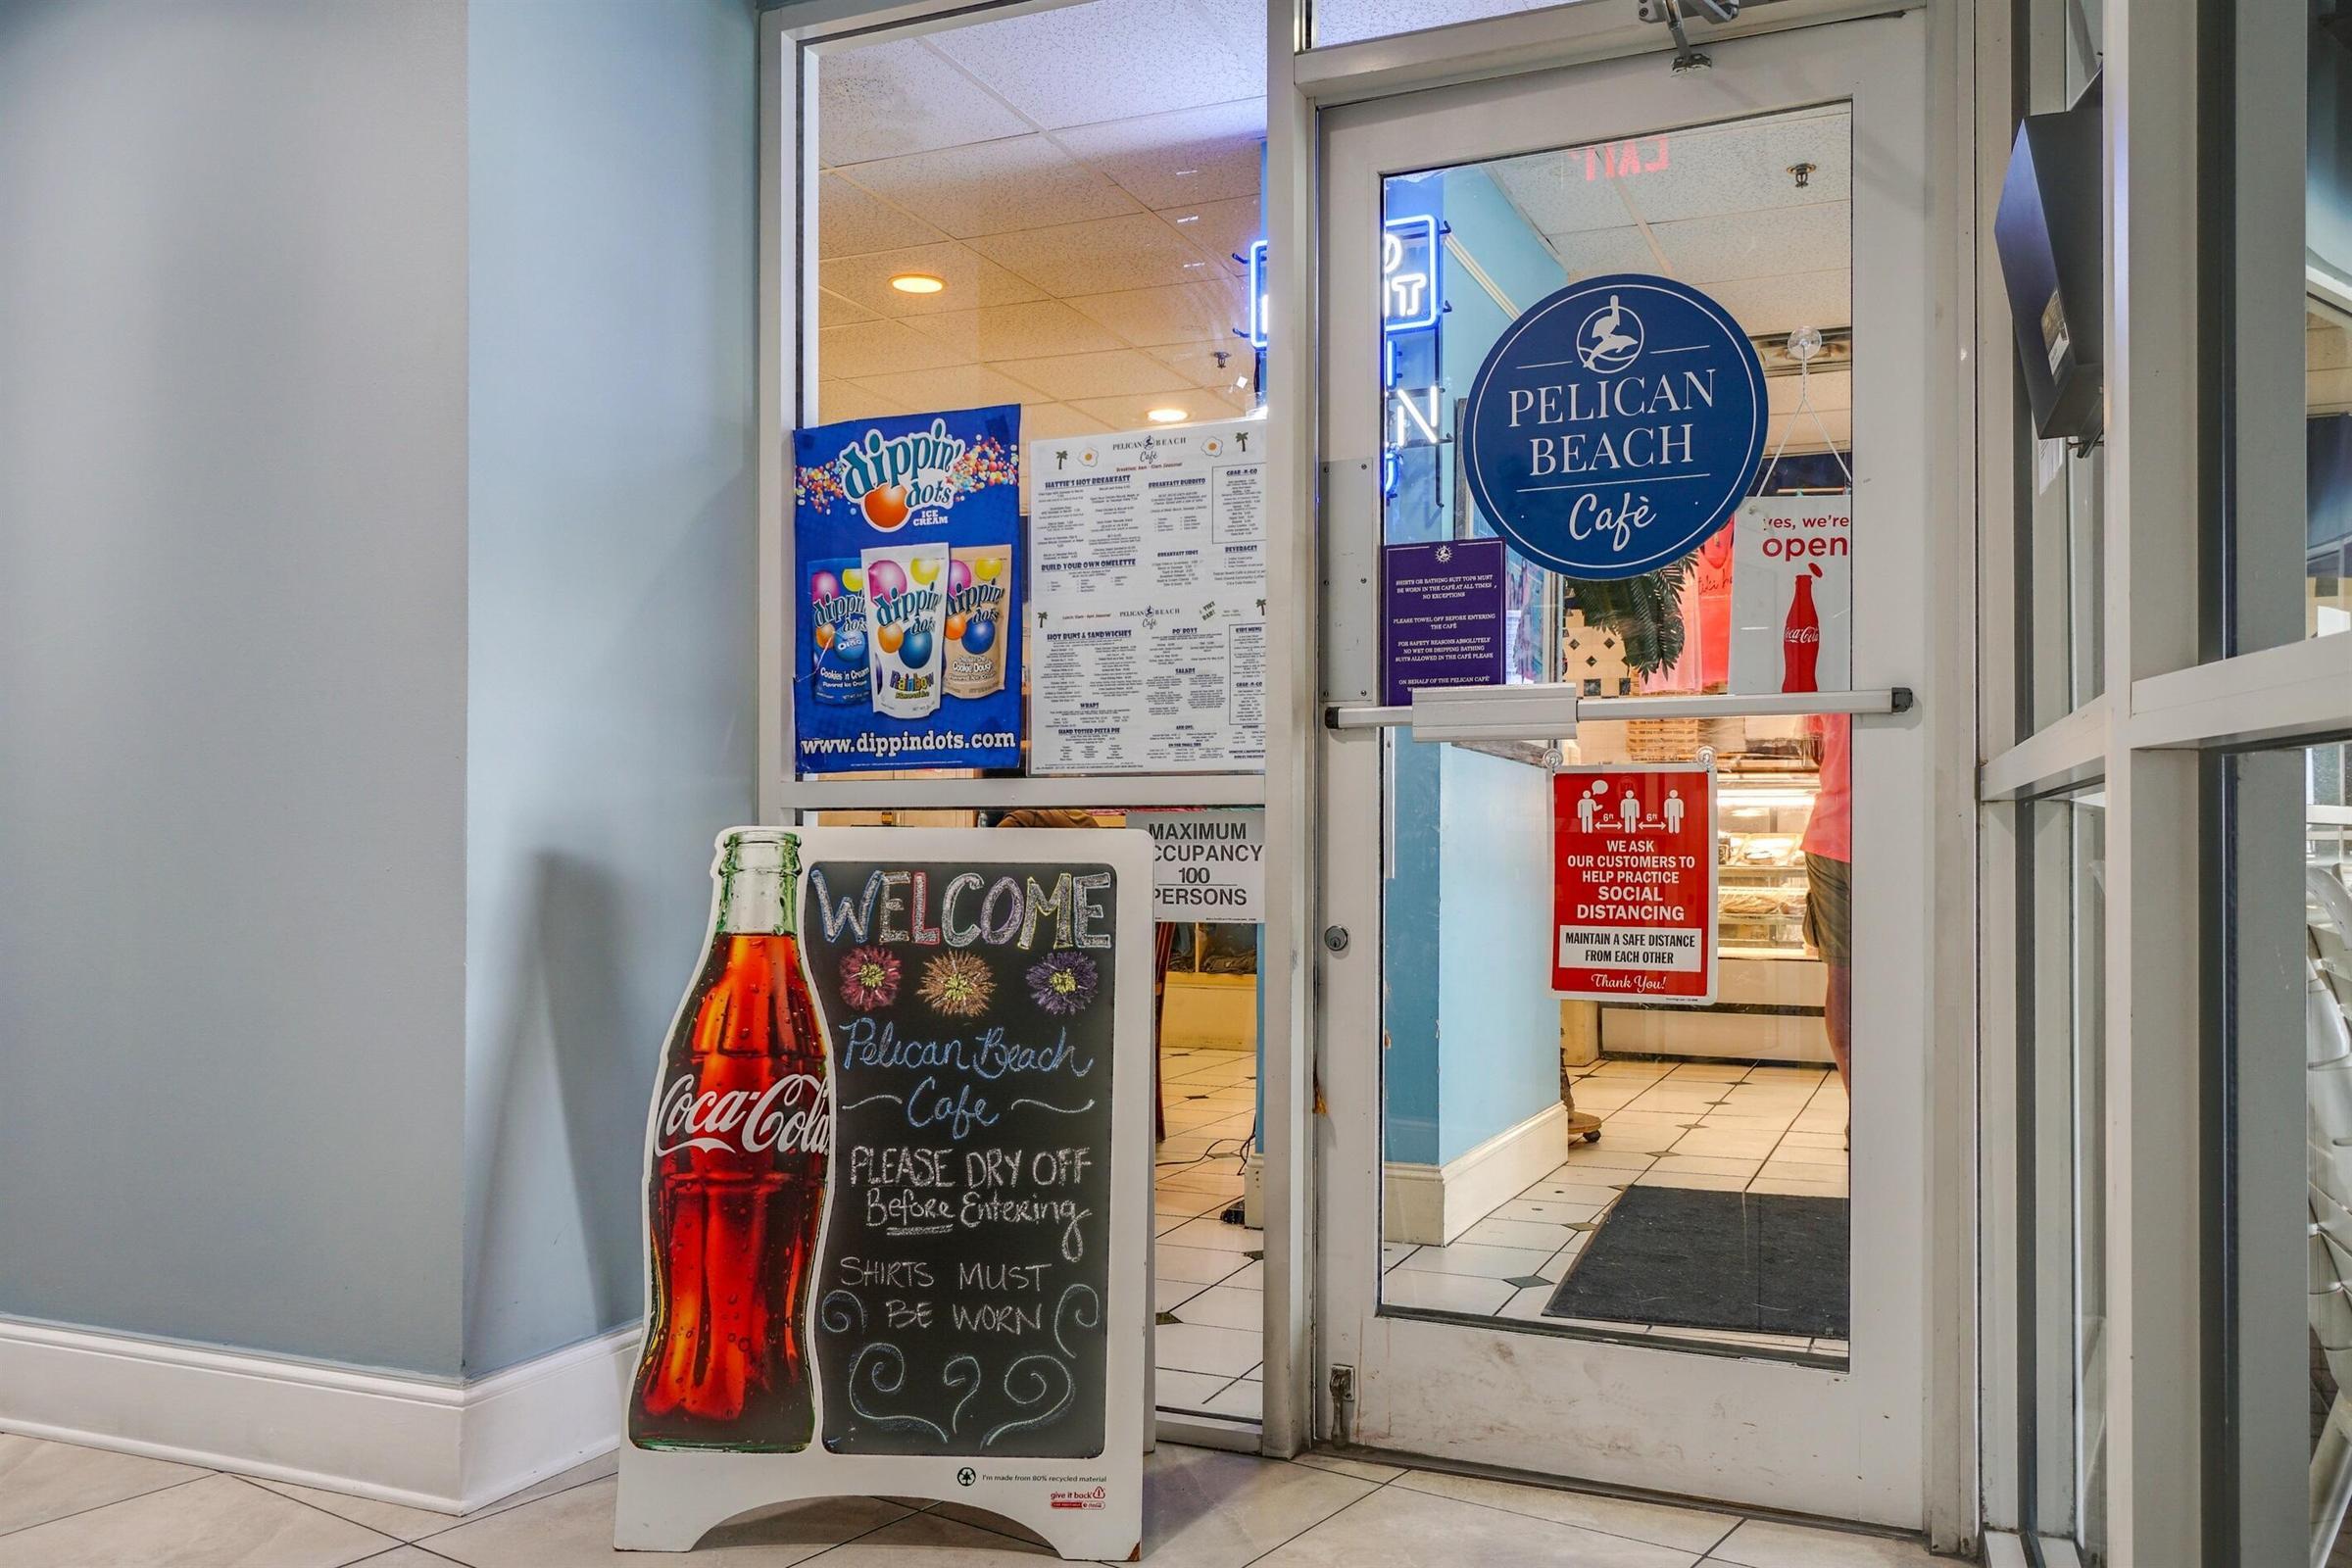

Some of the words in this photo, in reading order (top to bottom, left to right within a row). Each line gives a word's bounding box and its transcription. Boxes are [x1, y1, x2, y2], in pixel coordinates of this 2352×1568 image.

[1507, 368, 1715, 427] PELICAN
[1113, 442, 1142, 451] PELICAN
[1156, 437, 1186, 446] BEACH
[1529, 424, 1693, 475] BEACH
[1092, 475, 1130, 484] BREAKFAST
[906, 480, 951, 508] dots
[913, 516, 948, 526] CREAM
[1802, 515, 1849, 528] we're
[1763, 537, 1847, 562] open
[1101, 559, 1136, 567] OMELETTE
[813, 589, 866, 625] dippi
[910, 614, 935, 635] dots
[1088, 629, 1132, 638] SANDWICHES
[890, 670, 934, 692] Rainbow
[801, 730, 1015, 757] www.dippindots.com
[1149, 823, 1246, 839] MAXIMUM
[1155, 845, 1262, 861] CCUPANCY
[1607, 840, 1626, 852] WE
[1628, 841, 1654, 853] ASK
[1568, 855, 1593, 867] OUR
[1597, 856, 1676, 868] CUSTOMERS
[1679, 856, 1694, 868] TO
[1178, 867, 1210, 883] 100
[1583, 870, 1615, 883] HELP
[1618, 871, 1679, 883] PRACTICE
[1598, 886, 1663, 901] SOCIAL
[810, 868, 1112, 951] WELCOME
[1577, 905, 1685, 920] DISTANCING
[1566, 933, 1610, 946] MAINTAIN
[1613, 934, 1620, 946] A
[1622, 934, 1645, 947] SAFE
[1648, 935, 1694, 948] DISTANCE
[1585, 950, 1611, 962] FROM
[1615, 951, 1640, 962] EACH
[1642, 952, 1673, 964] OTHER
[1592, 973, 1633, 988] Thank
[1635, 975, 1667, 993] You!
[839, 1016, 971, 1070] Pelican
[972, 1025, 1095, 1078] Beach
[851, 1145, 956, 1188] PLEASE
[965, 1149, 1022, 1189] DRY
[1033, 1148, 1093, 1186] OFF
[840, 1256, 934, 1288] SHIRTS
[959, 1262, 1053, 1292] MUST
[886, 1300, 933, 1328] BE
[953, 1303, 1042, 1335] WORN
